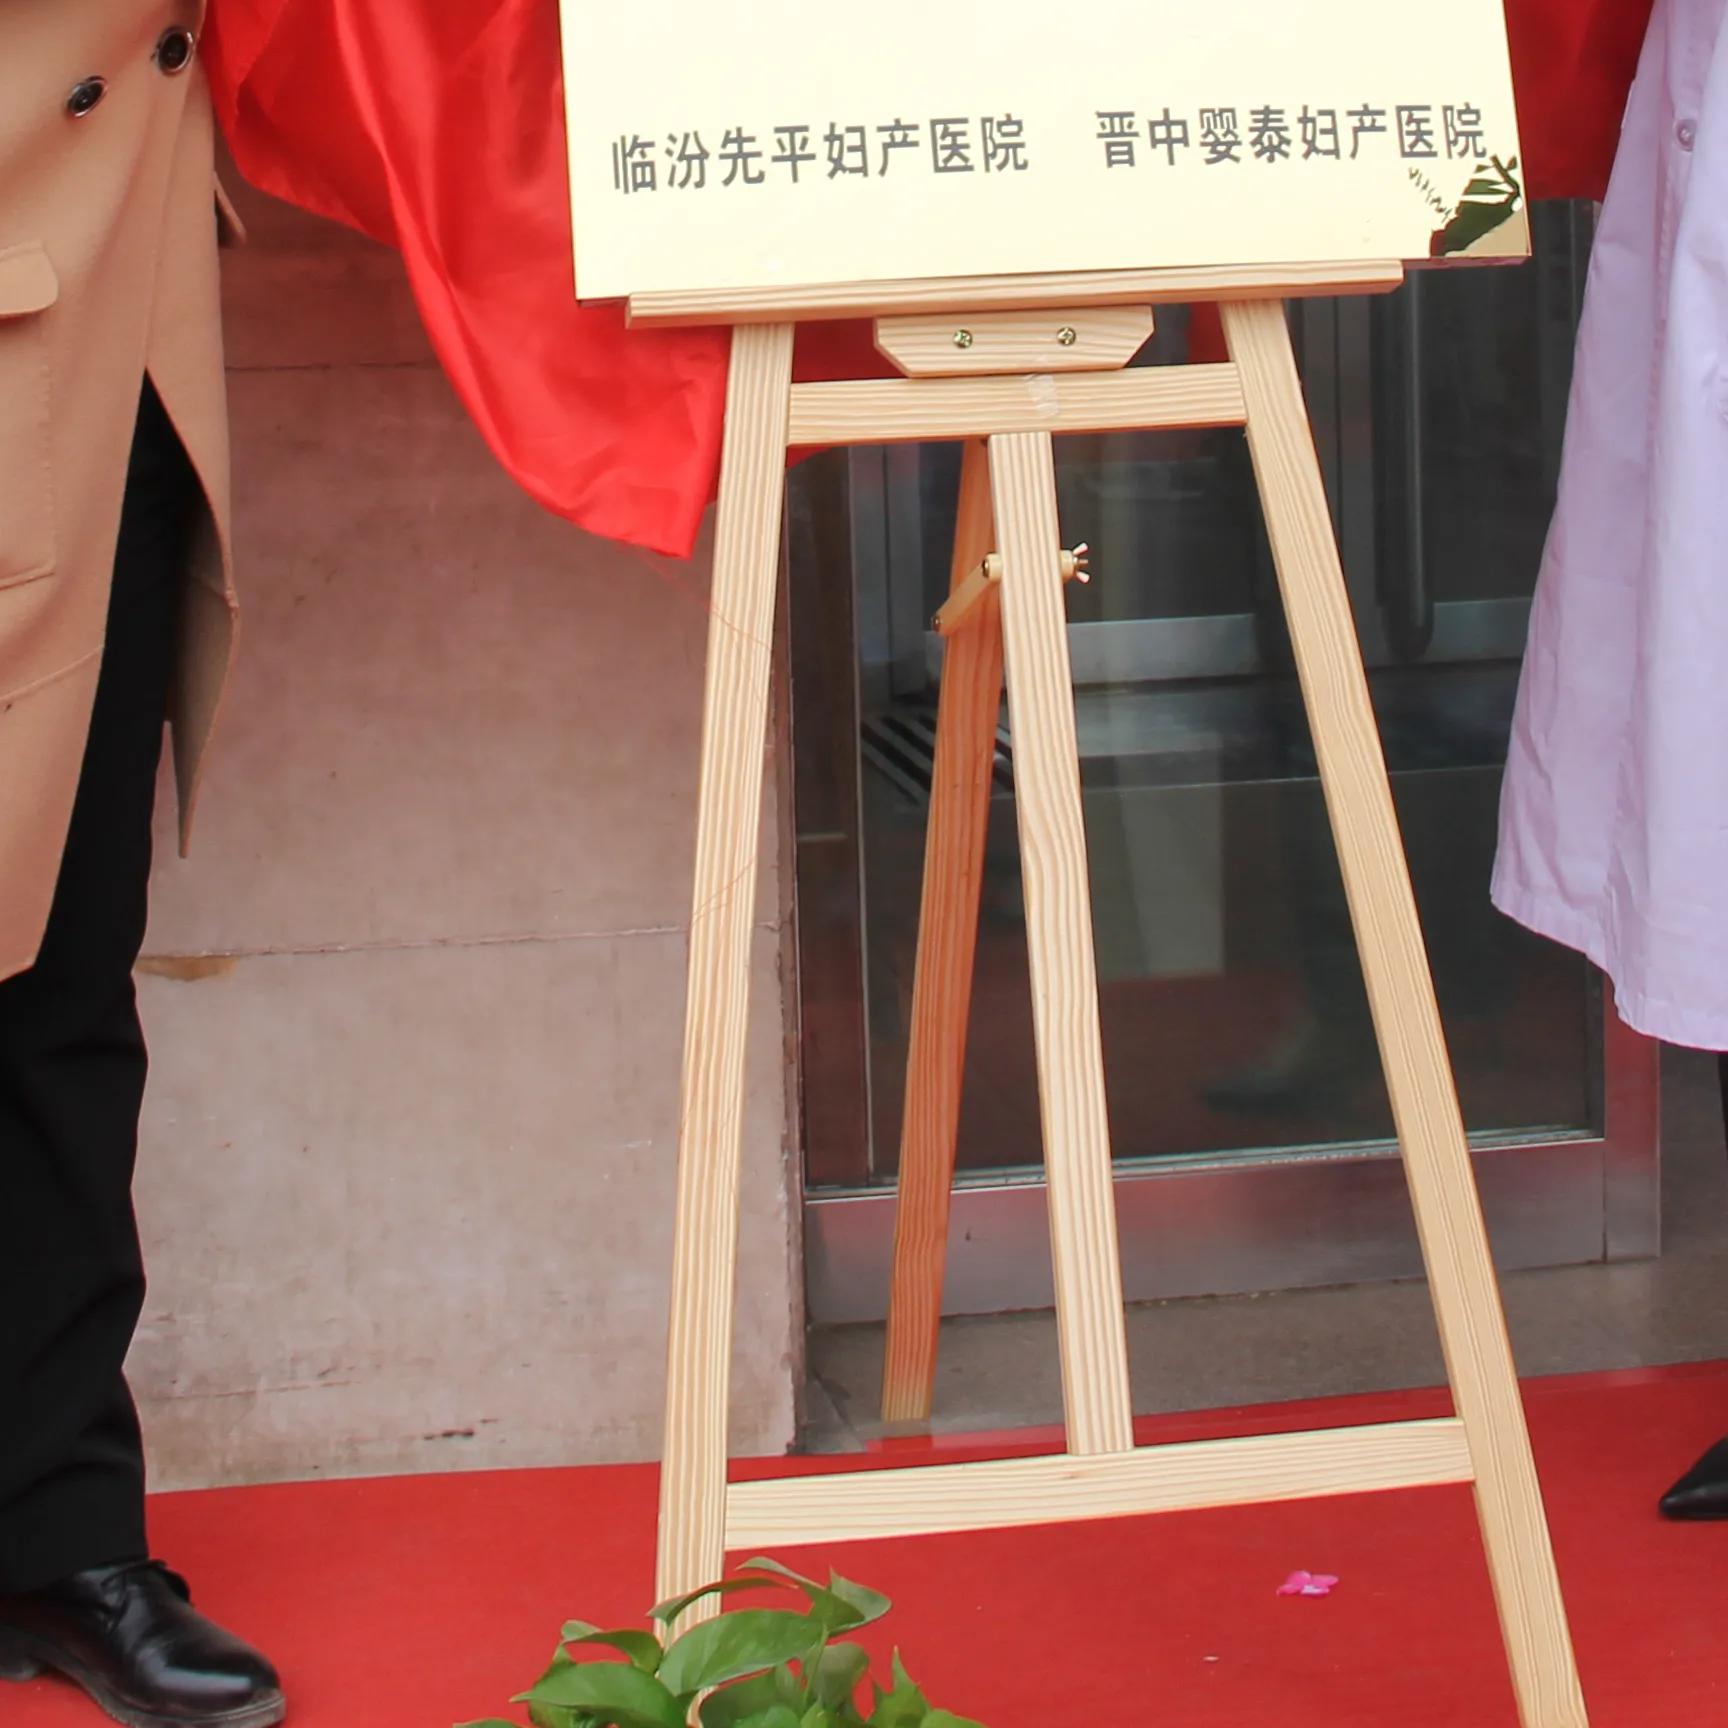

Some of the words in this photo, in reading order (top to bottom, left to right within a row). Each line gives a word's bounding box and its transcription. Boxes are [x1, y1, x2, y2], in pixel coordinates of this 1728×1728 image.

[611, 113, 1029, 195] 临汾先平妇产医院
[1095, 102, 1488, 170] 晋中婴泰妇产医院
